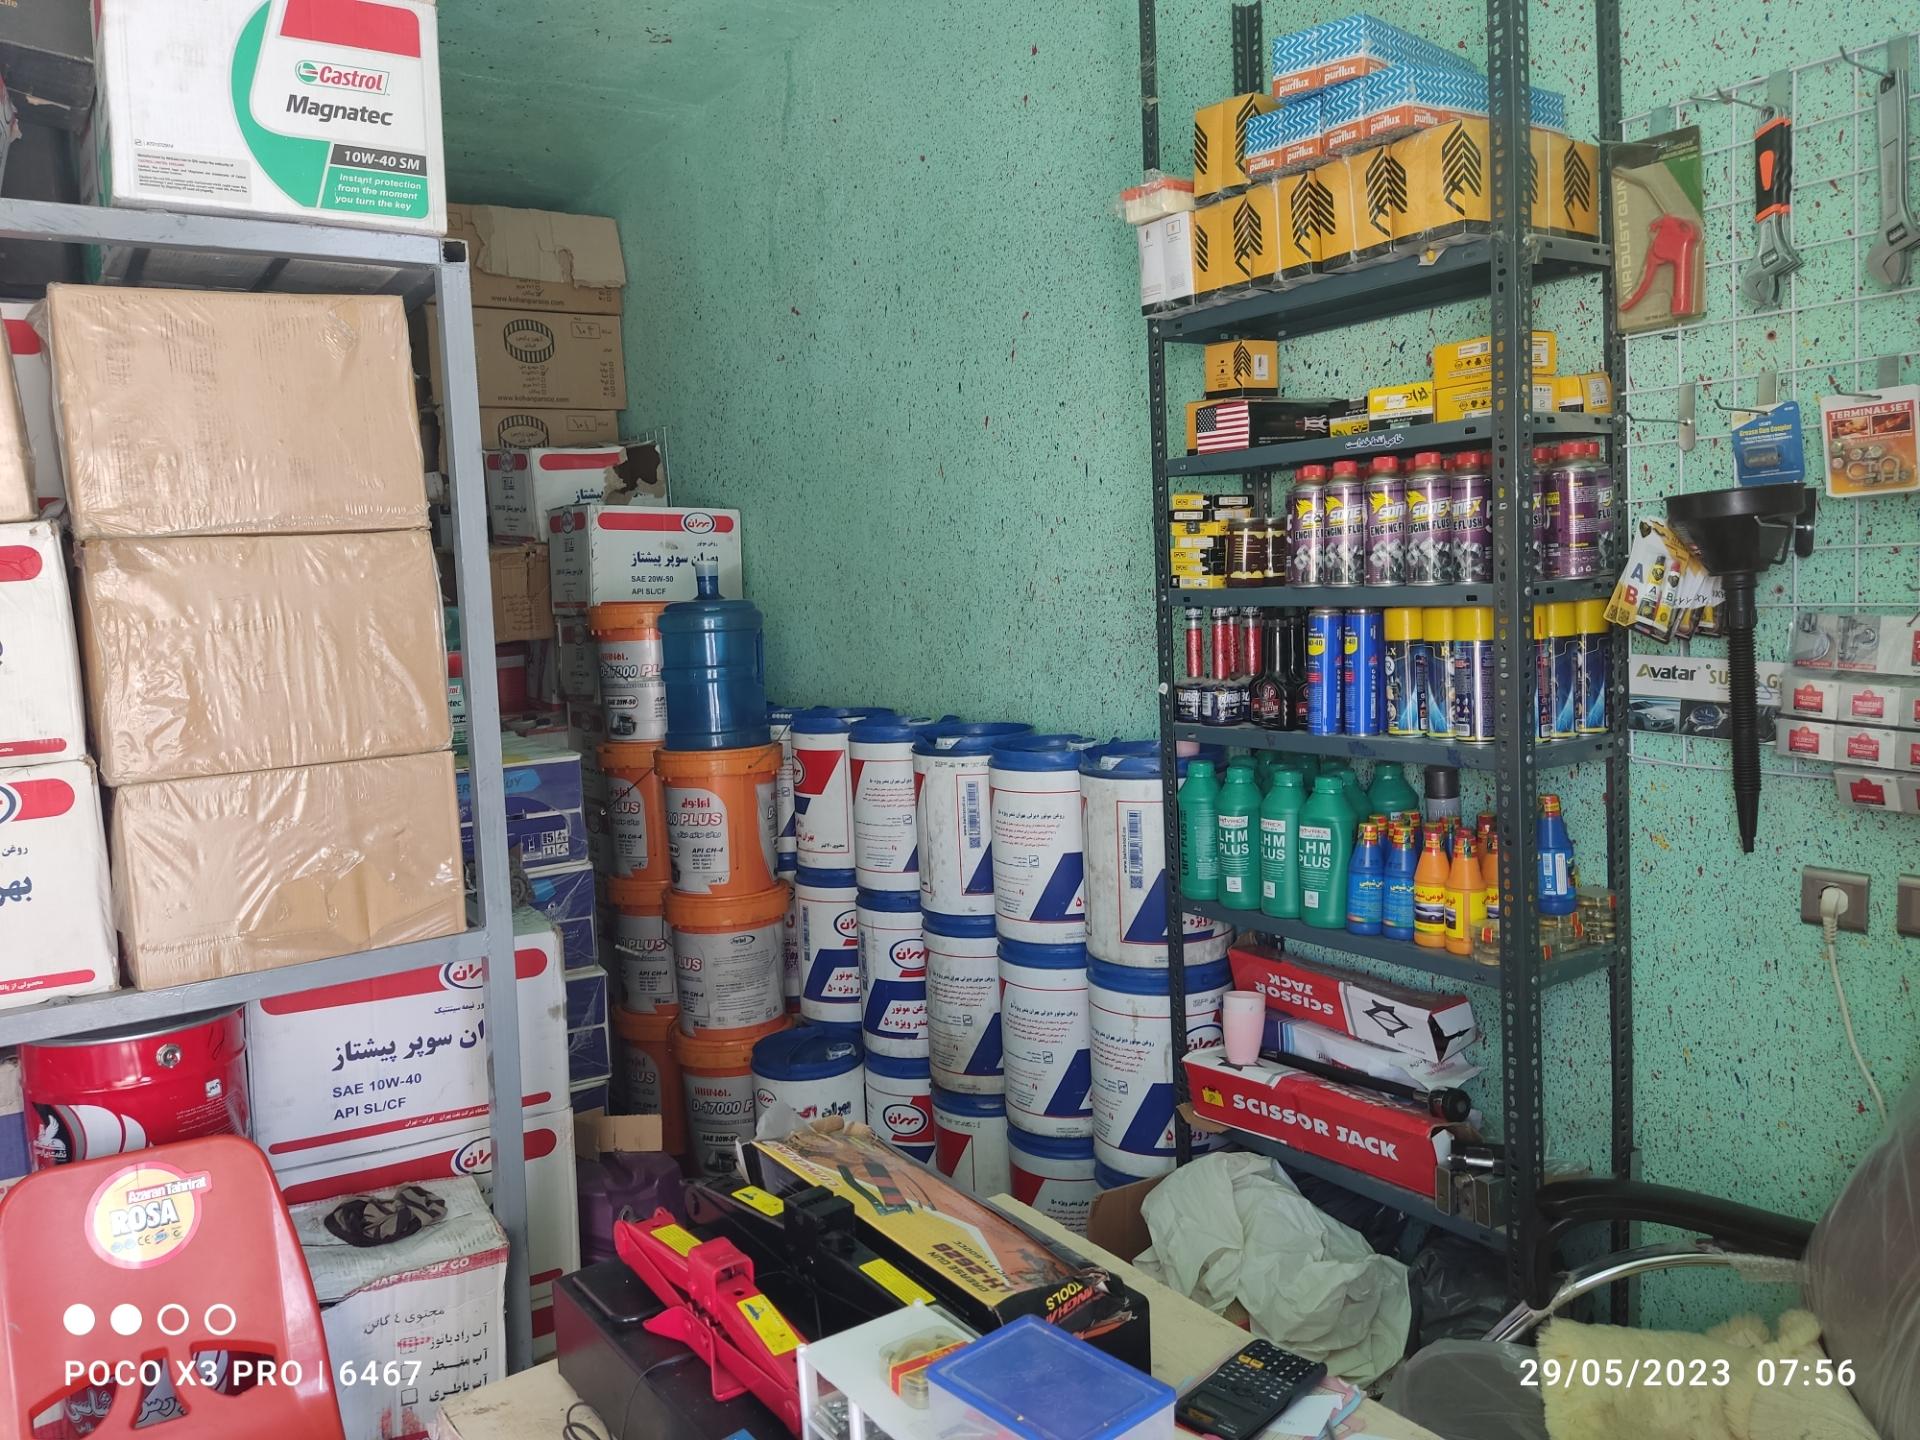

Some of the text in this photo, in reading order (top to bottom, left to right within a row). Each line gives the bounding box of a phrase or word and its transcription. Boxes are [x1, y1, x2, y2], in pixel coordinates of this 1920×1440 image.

[319, 66, 383, 91] Castrol
[1324, 65, 1356, 84] purflux
[1280, 79, 1309, 97] purflux
[286, 95, 393, 126] Magnatec
[1371, 114, 1400, 134] purflux
[1330, 130, 1356, 147] purflux
[344, 150, 421, 171] 10W-40 SM
[1287, 145, 1313, 163] purflux
[1249, 158, 1275, 174] purflux
[340, 173, 422, 190] Instant protection
[337, 184, 418, 200] from the moment
[1616, 177, 1628, 217] GUN
[335, 195, 412, 211] you turn the key
[1619, 219, 1631, 268] DUST
[1830, 402, 1910, 419] TERMINAL SET
[1345, 437, 1372, 451] خداست
[1372, 435, 1388, 447] فقط
[1432, 518, 1450, 530] FLUS
[631, 551, 688, 567] سوپر پیشتاز
[631, 575, 674, 583] SAE 20W-50
[1631, 563, 1644, 584] A
[632, 587, 667, 595] API SL/CF
[1624, 585, 1638, 606] B
[1649, 586, 1657, 595] A
[1666, 592, 1673, 602] B
[640, 664, 661, 677] PL
[1636, 663, 1697, 682] Avatar
[1263, 686, 1275, 698] STP
[680, 812, 723, 826] PLUS
[2, 844, 29, 858] روغن
[1219, 843, 1250, 855] PLUS
[675, 954, 703, 971] LUS
[20, 979, 44, 990] محصولی
[835, 971, 853, 981] موتور
[1267, 973, 1313, 996] JACK
[827, 984, 854, 994] ویژه ۵۰
[1255, 981, 1334, 1016] SCISSOR
[892, 1004, 910, 1014] موتور
[884, 1017, 911, 1030] ویژه ۵۰
[331, 1030, 453, 1071] سوپر پیشتاز
[333, 1073, 423, 1098] SAE 10W-40
[631, 1072, 656, 1084] LUS
[334, 1097, 407, 1121] API SL/CF
[888, 1112, 919, 1125] بهران
[1232, 1093, 1399, 1162] SCISSOR JACK
[127, 1175, 206, 1204] Azaran Tahrirat
[110, 1198, 181, 1238] ROSA
[450, 1258, 470, 1270] CO
[927, 1251, 950, 1266] GUN
[947, 1264, 990, 1293] GREASE
[1045, 1280, 1083, 1311] TOOLS
[405, 1310, 445, 1323] محتوی
[430, 1322, 488, 1350] آب رادیاتور
[430, 1347, 488, 1376] آب مقطر
[429, 1373, 488, 1402] آب باطری
